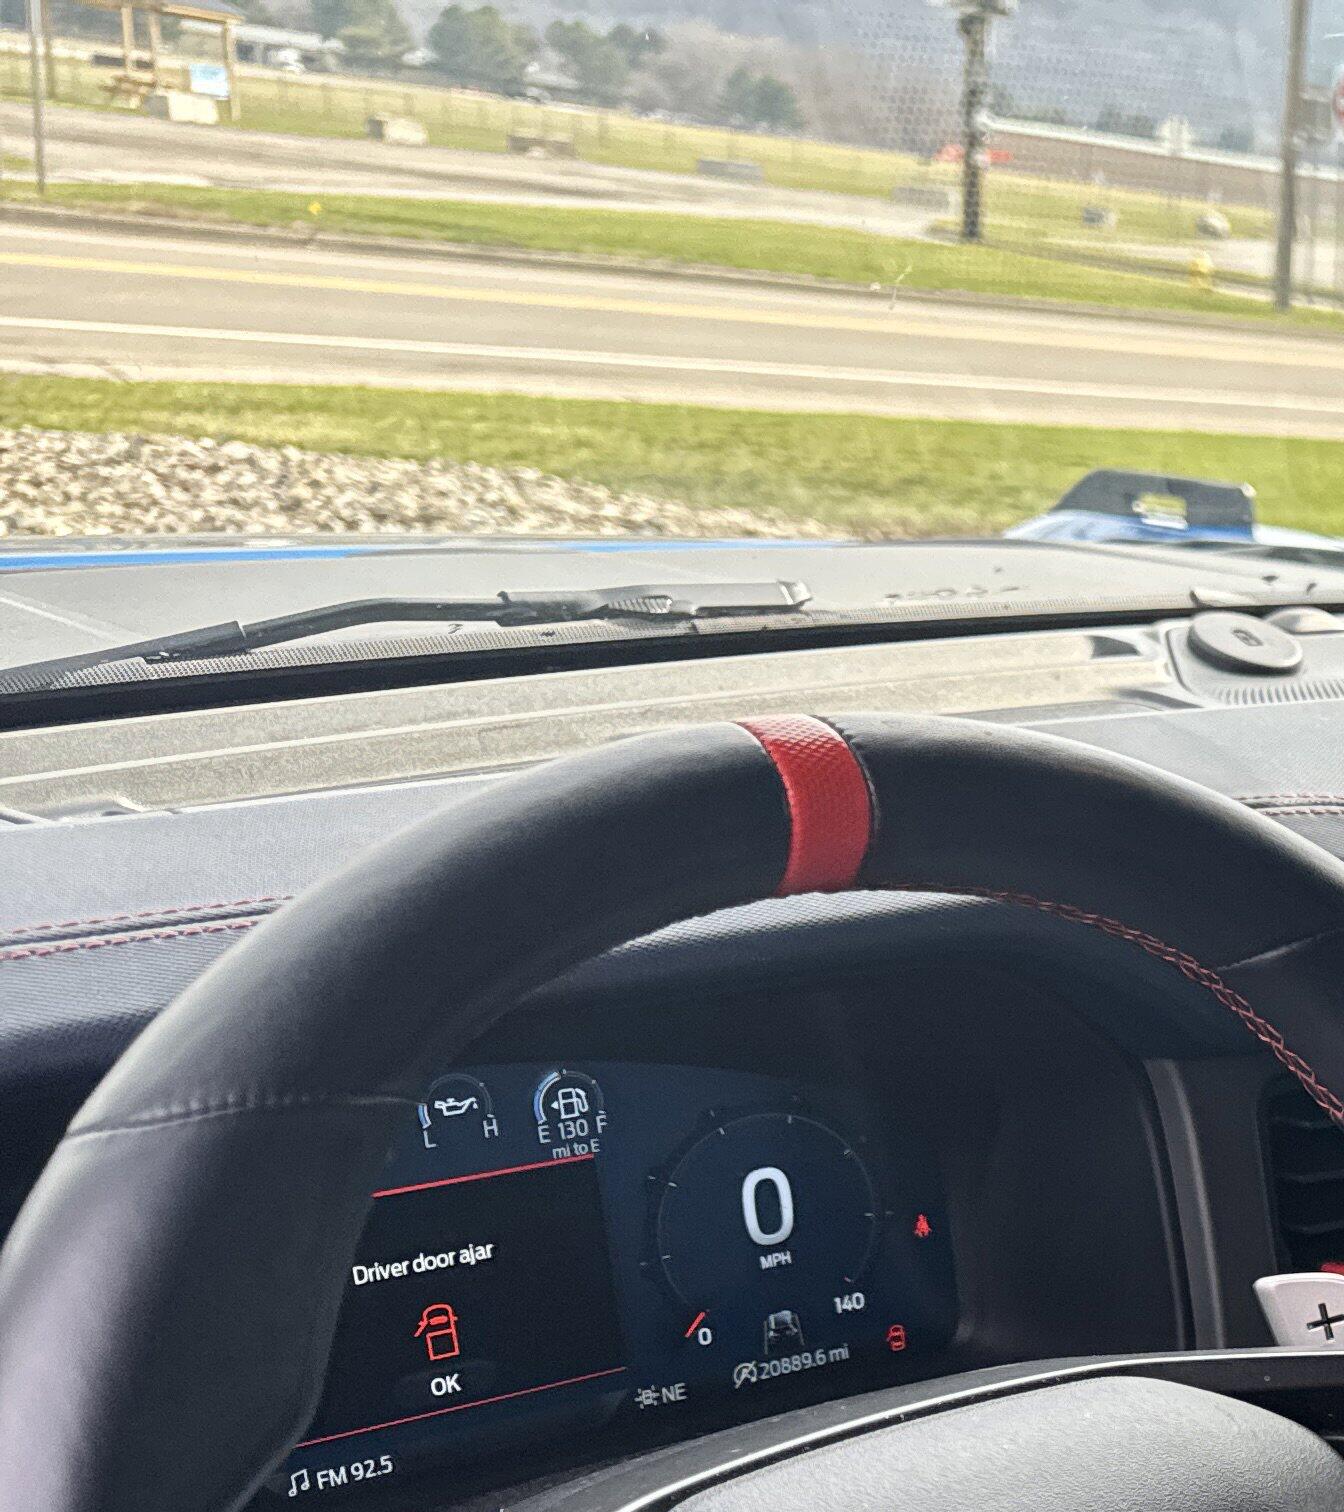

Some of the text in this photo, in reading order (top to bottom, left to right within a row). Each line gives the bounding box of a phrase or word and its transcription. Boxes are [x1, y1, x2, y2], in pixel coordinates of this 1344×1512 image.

[557, 1119, 589, 1140] 130
[741, 1166, 794, 1246] 0
[352, 1243, 495, 1285] Driver door ajar
[759, 1250, 793, 1271] MPH
[833, 1291, 866, 1314] 140
[759, 1350, 827, 1381] 20889.6
[430, 1373, 462, 1397] OK
[316, 1455, 394, 1490] FM 92.5
